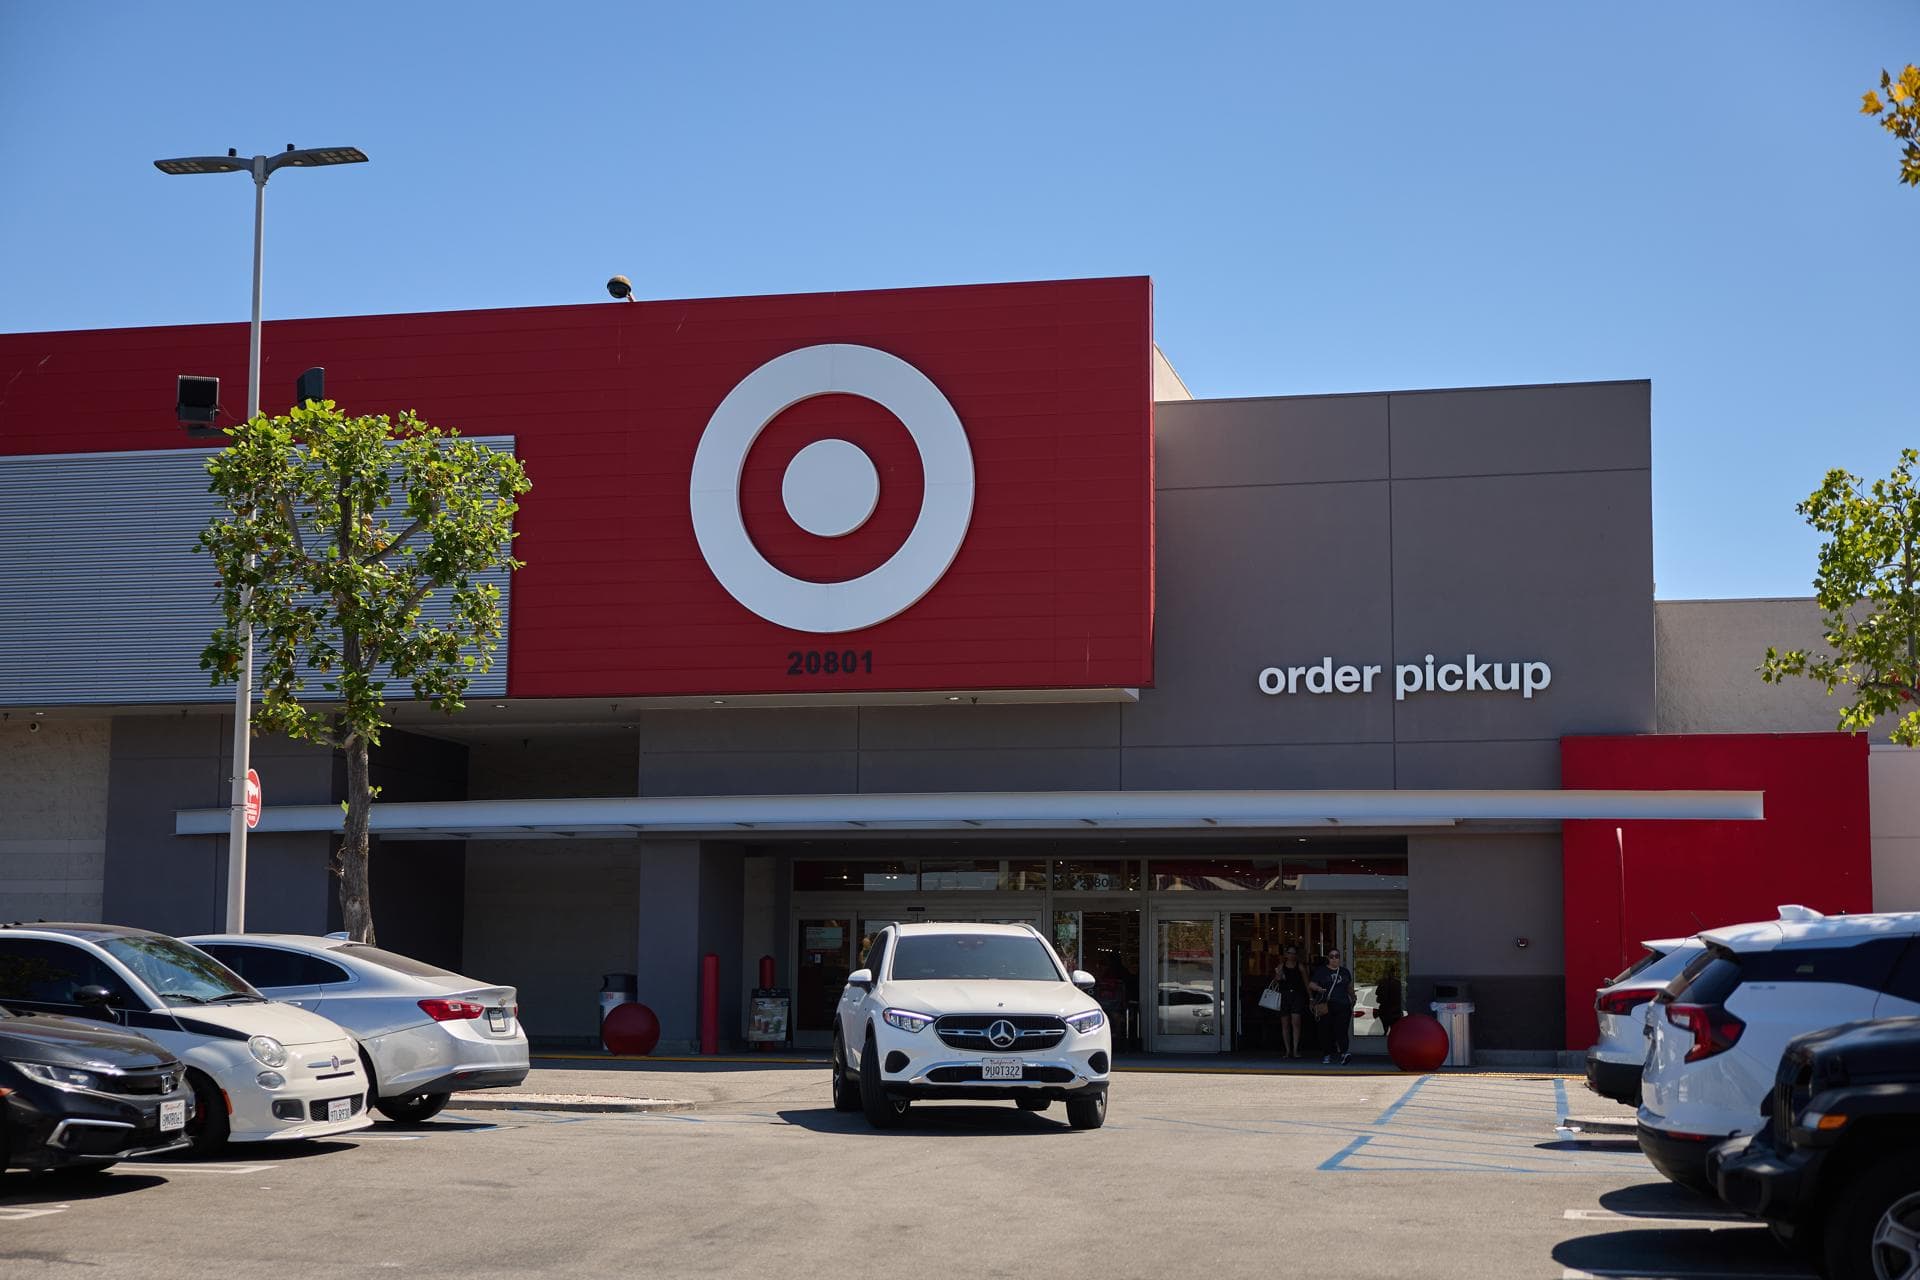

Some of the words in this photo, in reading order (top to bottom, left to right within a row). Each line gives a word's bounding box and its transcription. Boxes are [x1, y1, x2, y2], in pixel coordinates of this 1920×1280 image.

[787, 650, 872, 675] 20801
[1258, 656, 1381, 694] order
[1396, 654, 1551, 700] pickup
